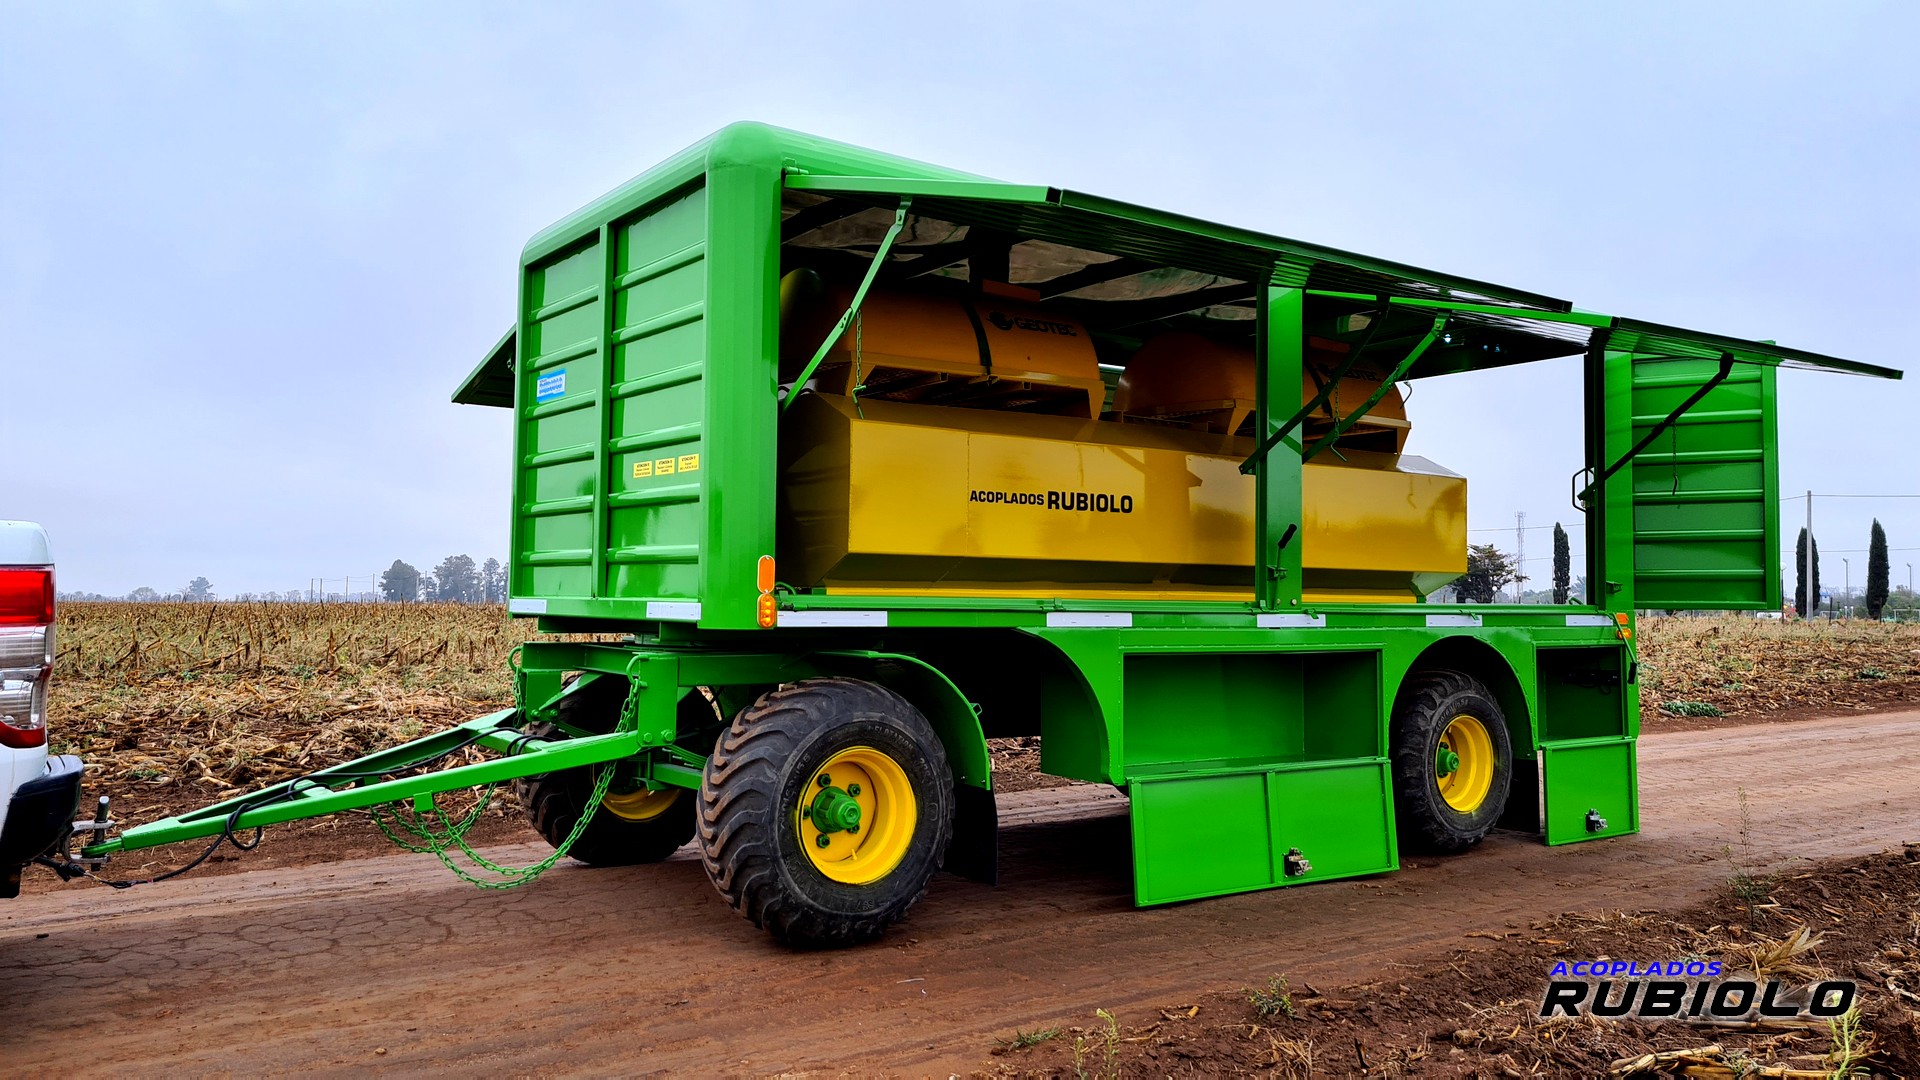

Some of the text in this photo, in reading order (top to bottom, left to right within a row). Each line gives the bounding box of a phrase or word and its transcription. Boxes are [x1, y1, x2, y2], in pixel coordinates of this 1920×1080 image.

[1013, 316, 1078, 336] GEOTEC
[969, 490, 1134, 514] ACOPLADOS RUBIOLO
